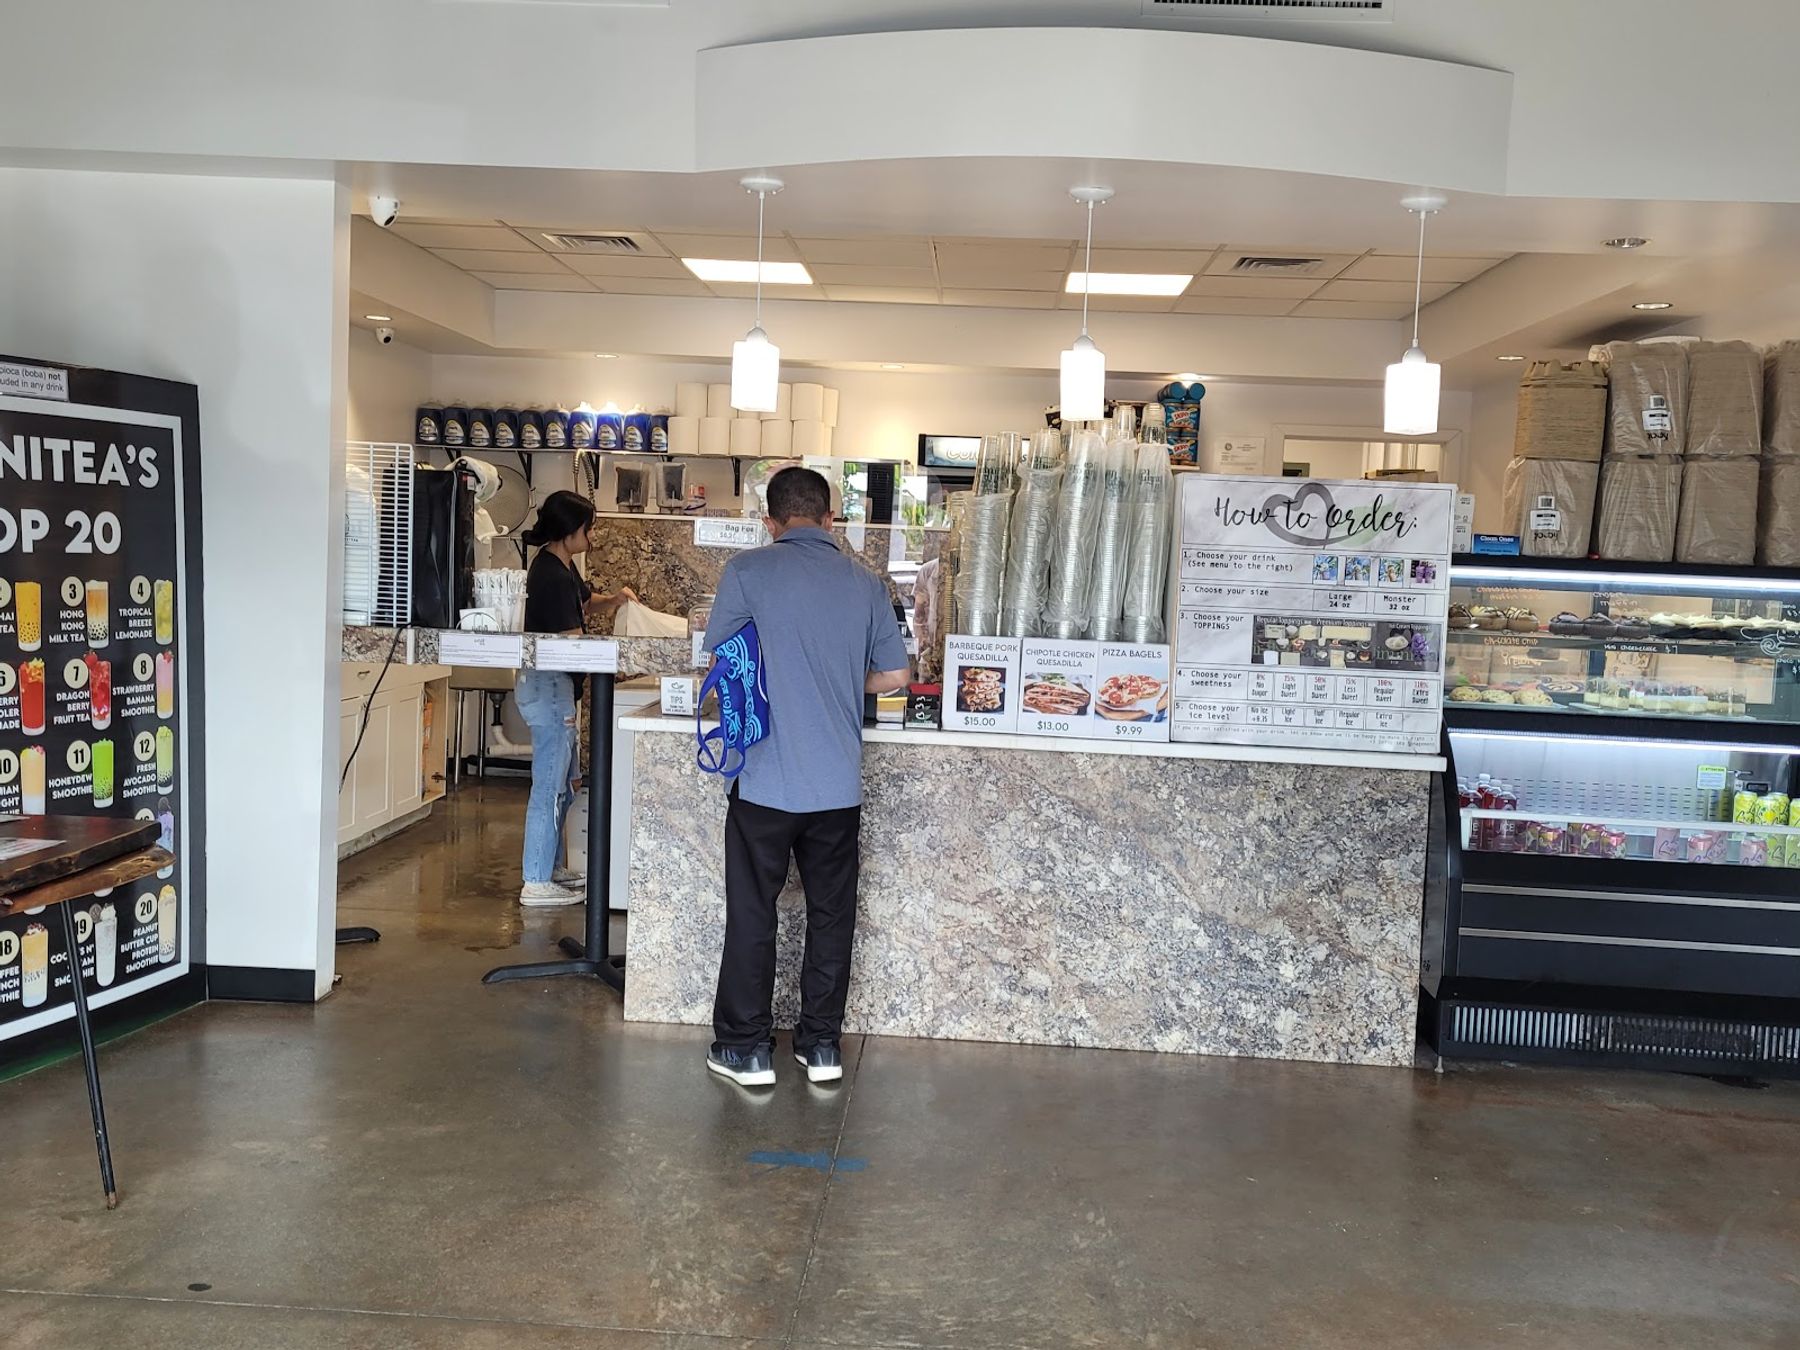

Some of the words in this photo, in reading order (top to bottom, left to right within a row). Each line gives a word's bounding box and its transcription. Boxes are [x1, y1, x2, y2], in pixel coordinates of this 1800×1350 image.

[0, 367, 20, 376] ioca
[22, 369, 46, 379] (boba)
[48, 372, 61, 380] not
[0, 379, 19, 387] uded
[22, 380, 29, 388] in
[31, 382, 43, 391] any
[0, 434, 160, 489] NITEA'S
[1214, 496, 1277, 527] How
[1326, 493, 1417, 538] Order:
[64, 510, 122, 555] 20
[1196, 552, 1225, 560] Choose
[1228, 554, 1247, 562] your
[1187, 560, 1207, 568] (See
[1247, 562, 1262, 570] the
[1265, 563, 1294, 572] right)
[68, 583, 77, 600] 3
[137, 582, 144, 597] 4
[1250, 588, 1269, 596] size
[1329, 592, 1353, 601] Large
[1383, 595, 1417, 603] Monster
[0, 612, 14, 621] HAI
[59, 610, 85, 619] HONG
[118, 607, 152, 617] TROPICAL
[1180, 612, 1188, 620] 3.
[1193, 613, 1222, 621] Choose
[61, 621, 85, 631] KONG
[128, 618, 152, 628] BREEZE
[1193, 622, 1230, 630] TOPPINGS
[49, 634, 69, 643] MILK
[70, 633, 85, 642] TEA
[115, 630, 153, 640] LEMONADE
[949, 641, 993, 652] BARBEQUE
[995, 643, 1018, 653] PORK
[957, 652, 1009, 663] QUESADILLA
[1025, 648, 1061, 658] CHIPOTLE
[1062, 650, 1096, 659] CHICKEN
[1102, 648, 1127, 658] PIZZA
[1129, 649, 1162, 659] BAGELS
[140, 659, 147, 675] 8
[1036, 658, 1083, 668] QUESADILLA
[73, 665, 80, 682] 7
[1191, 670, 1219, 678] Choose
[56, 690, 90, 701] DRAGON
[112, 684, 155, 696] STRAWBERRY
[0, 696, 19, 706] ERRY
[126, 696, 155, 706] BANANA
[0, 707, 20, 717] OLER
[67, 702, 90, 712] BERRY
[121, 707, 156, 717] SMOOTHIE
[1189, 703, 1217, 711] Choose
[53, 714, 76, 725] FRUIT
[77, 713, 91, 723] TEA
[964, 716, 996, 727] $15.00
[1208, 712, 1230, 720] level
[0, 719, 20, 730] ADE
[1037, 721, 1069, 732] $13.00
[1115, 725, 1142, 736] $9.99
[139, 738, 150, 754] 12
[73, 748, 85, 765] 11
[136, 762, 157, 773] FRESH
[49, 773, 93, 788] HONEYDEW
[123, 774, 157, 787] AVOCADO
[52, 785, 93, 800] SMOOTHIE
[122, 785, 157, 799] SMOOTHIE
[0, 797, 20, 808] GHT
[140, 899, 152, 916] 20
[133, 922, 159, 937] PEANUT
[121, 938, 146, 953] BUTTER
[145, 933, 159, 944] CUP
[132, 946, 159, 960] PROTEIN
[125, 957, 159, 974] SMOOTHIE
[0, 966, 20, 977] FFEE
[0, 978, 20, 991] NCH
[0, 990, 20, 1003] THIE
